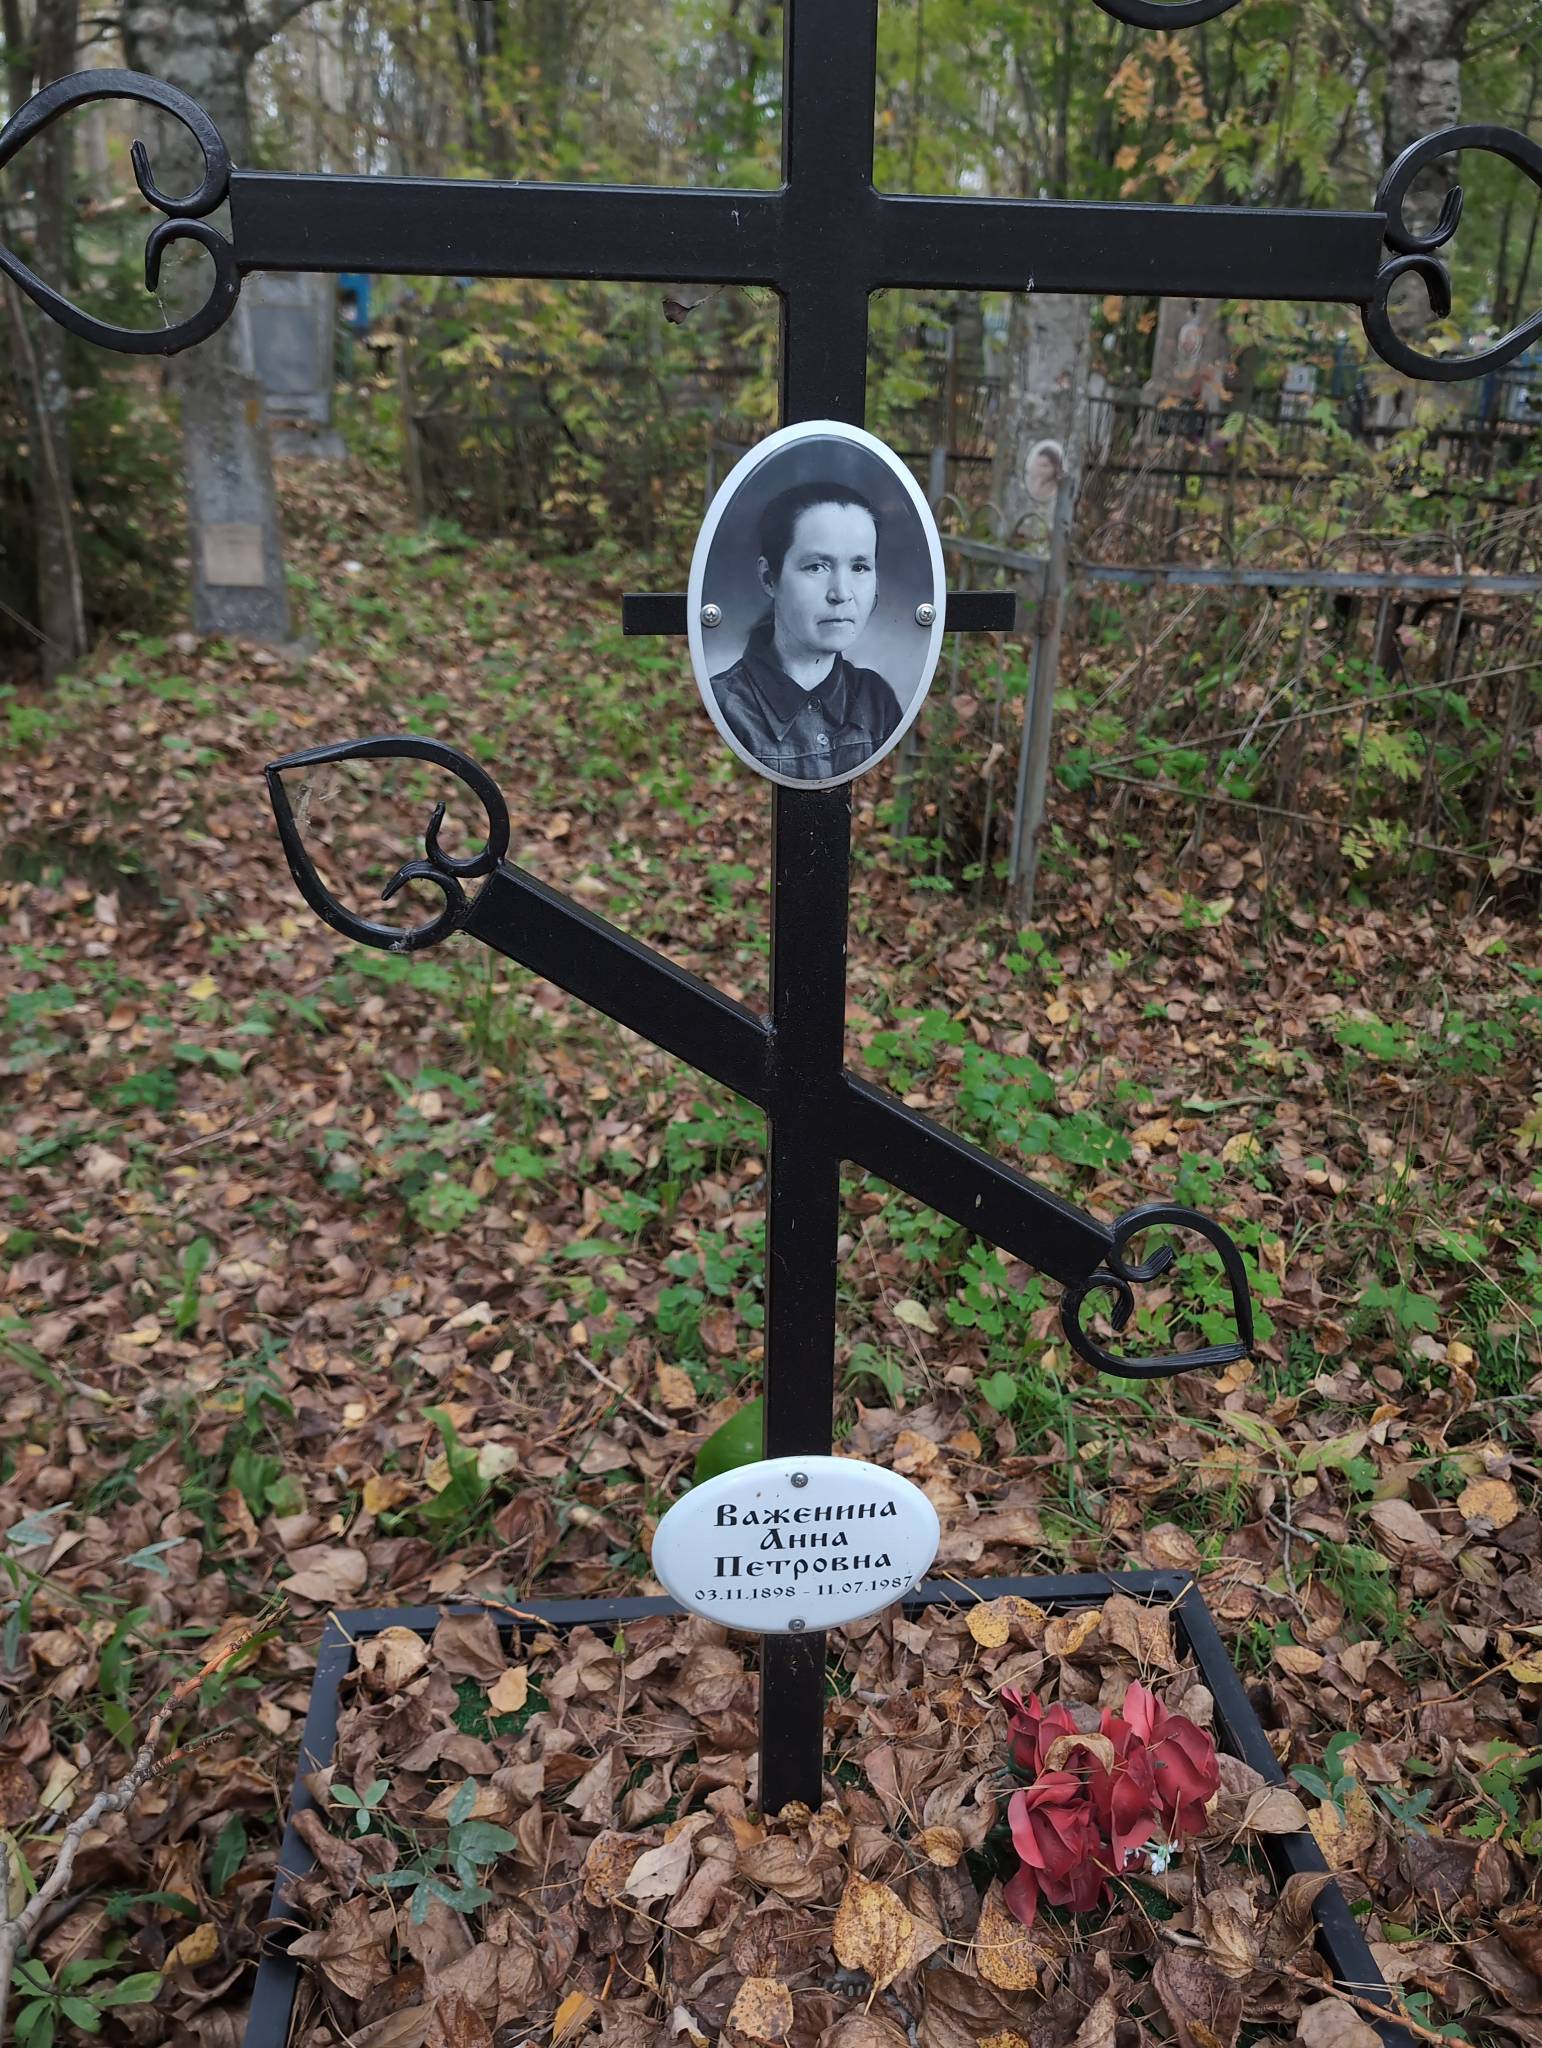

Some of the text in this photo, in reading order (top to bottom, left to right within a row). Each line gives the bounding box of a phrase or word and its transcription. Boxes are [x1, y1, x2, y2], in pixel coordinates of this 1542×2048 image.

[714, 1501, 898, 1527] Важенина
[760, 1527, 849, 1550] Анна
[714, 1554, 892, 1580] Петровна
[694, 1586, 796, 1601] 03.11.1898
[818, 1576, 913, 1596] 11.07.1987
